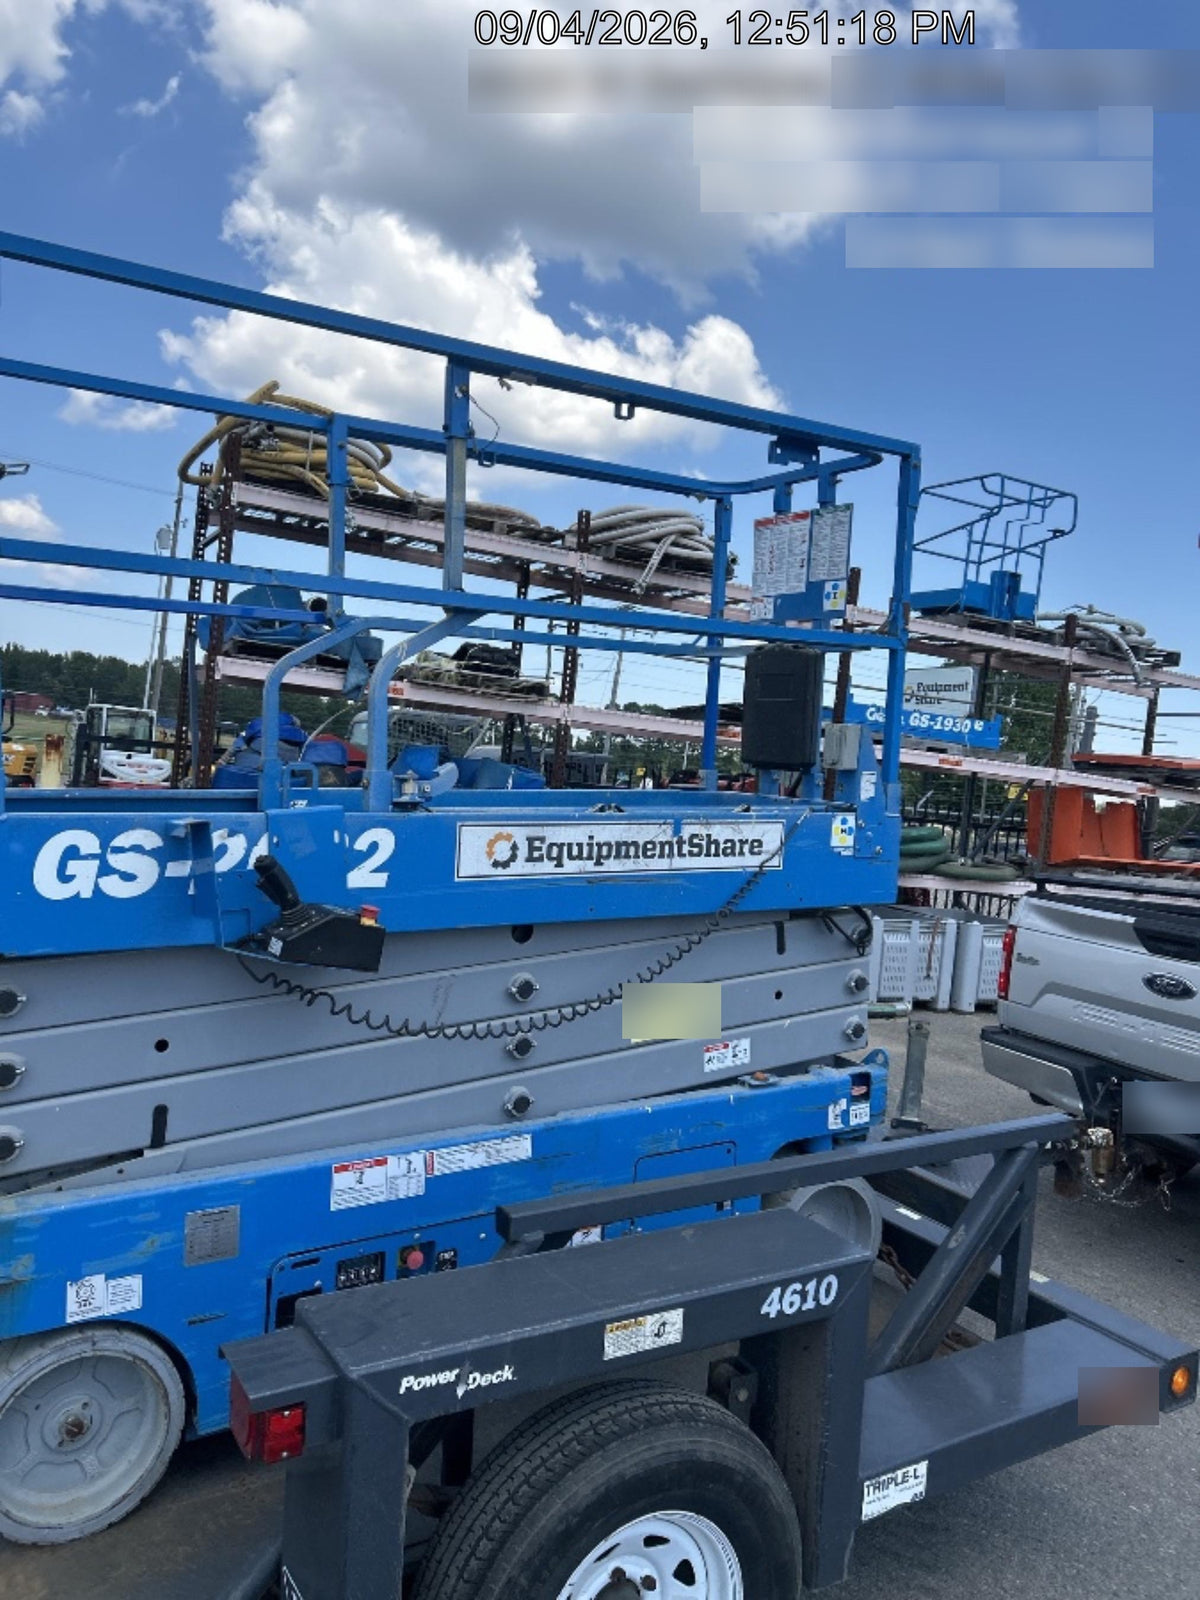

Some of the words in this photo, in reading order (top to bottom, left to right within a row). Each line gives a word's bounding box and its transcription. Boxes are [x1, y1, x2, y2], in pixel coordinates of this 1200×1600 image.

[917, 680, 969, 694] Equipment
[909, 712, 971, 733] GS-1930
[525, 833, 763, 867] EquipmentShare
[760, 1274, 838, 1318] 4610
[399, 1368, 460, 1394] Power
